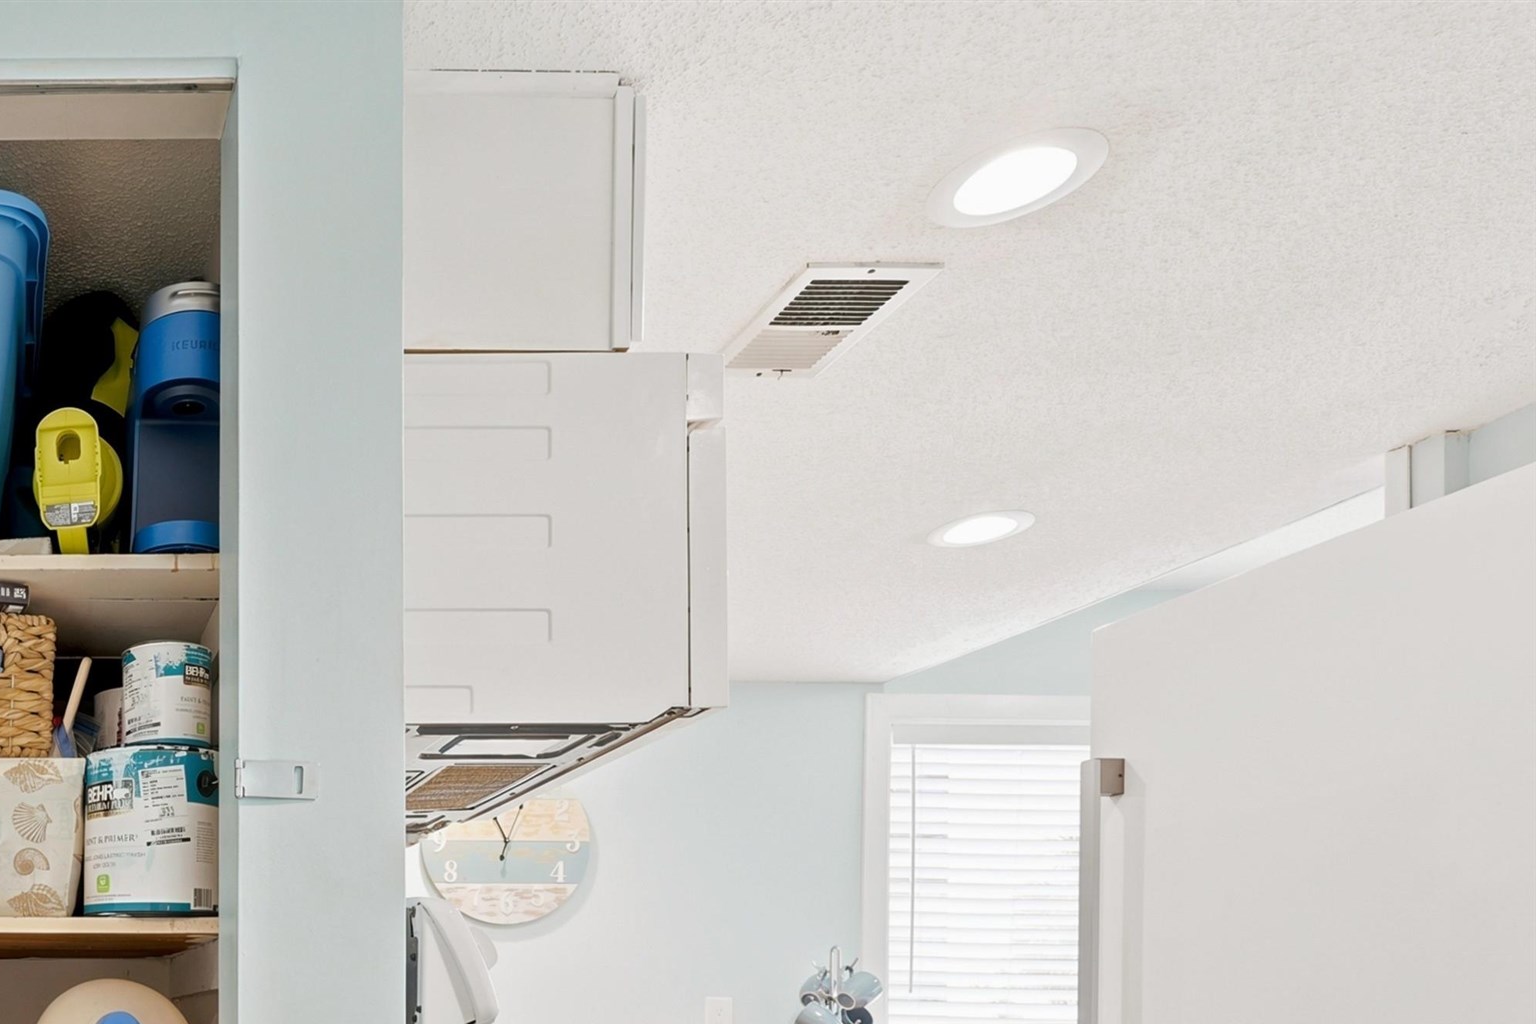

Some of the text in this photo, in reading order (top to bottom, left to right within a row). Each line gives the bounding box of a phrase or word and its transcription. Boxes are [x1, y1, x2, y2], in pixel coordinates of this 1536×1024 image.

[88, 784, 114, 803] BEHR
[556, 800, 569, 822] 2
[566, 831, 581, 853] 3
[444, 860, 458, 883] 8
[550, 860, 567, 883] 4
[500, 892, 514, 915] 6
